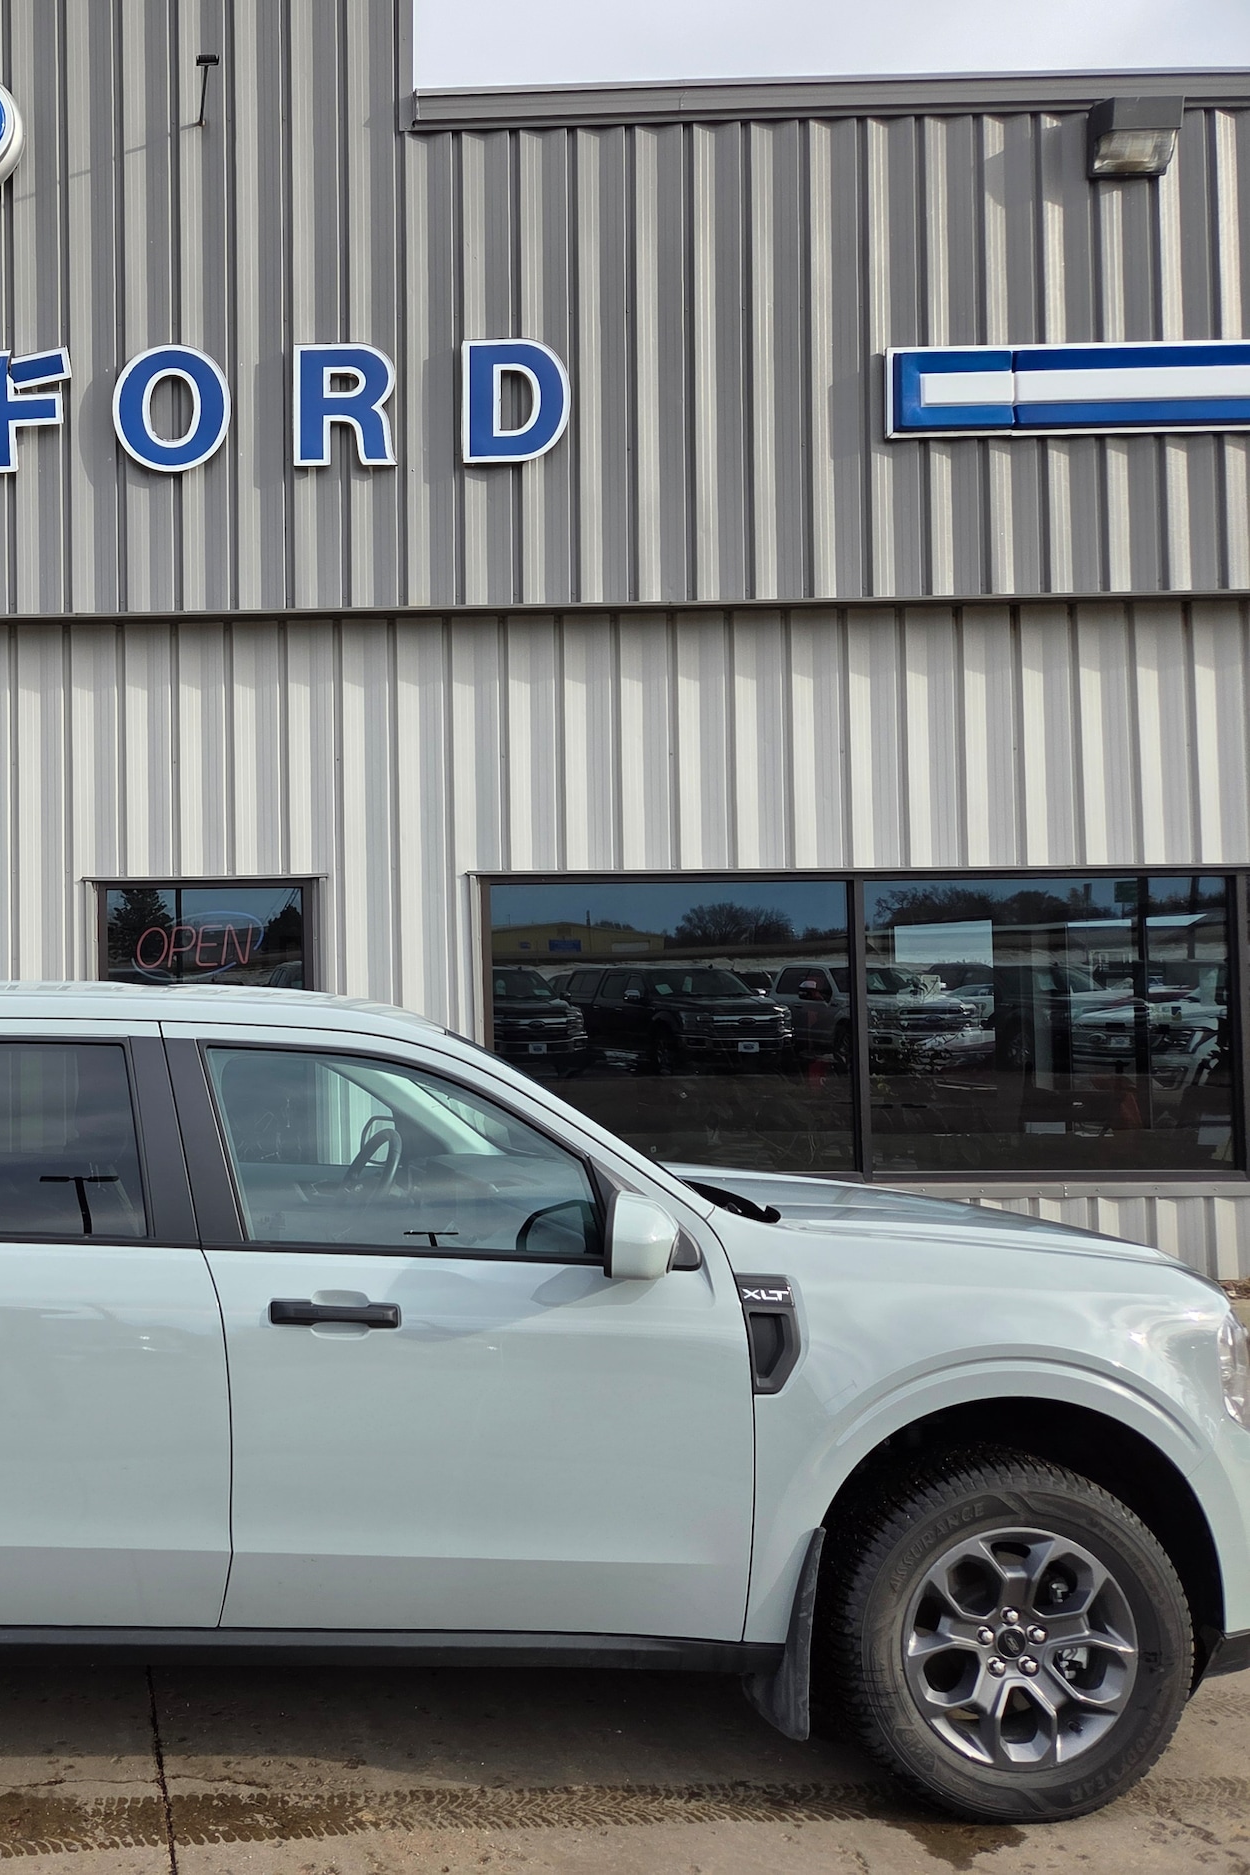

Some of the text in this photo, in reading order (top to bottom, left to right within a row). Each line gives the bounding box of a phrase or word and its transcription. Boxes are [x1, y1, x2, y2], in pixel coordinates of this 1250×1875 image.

[136, 923, 253, 969] OPEN
[741, 1288, 789, 1301] XLT
[889, 1502, 986, 1593] ASSURANCE
